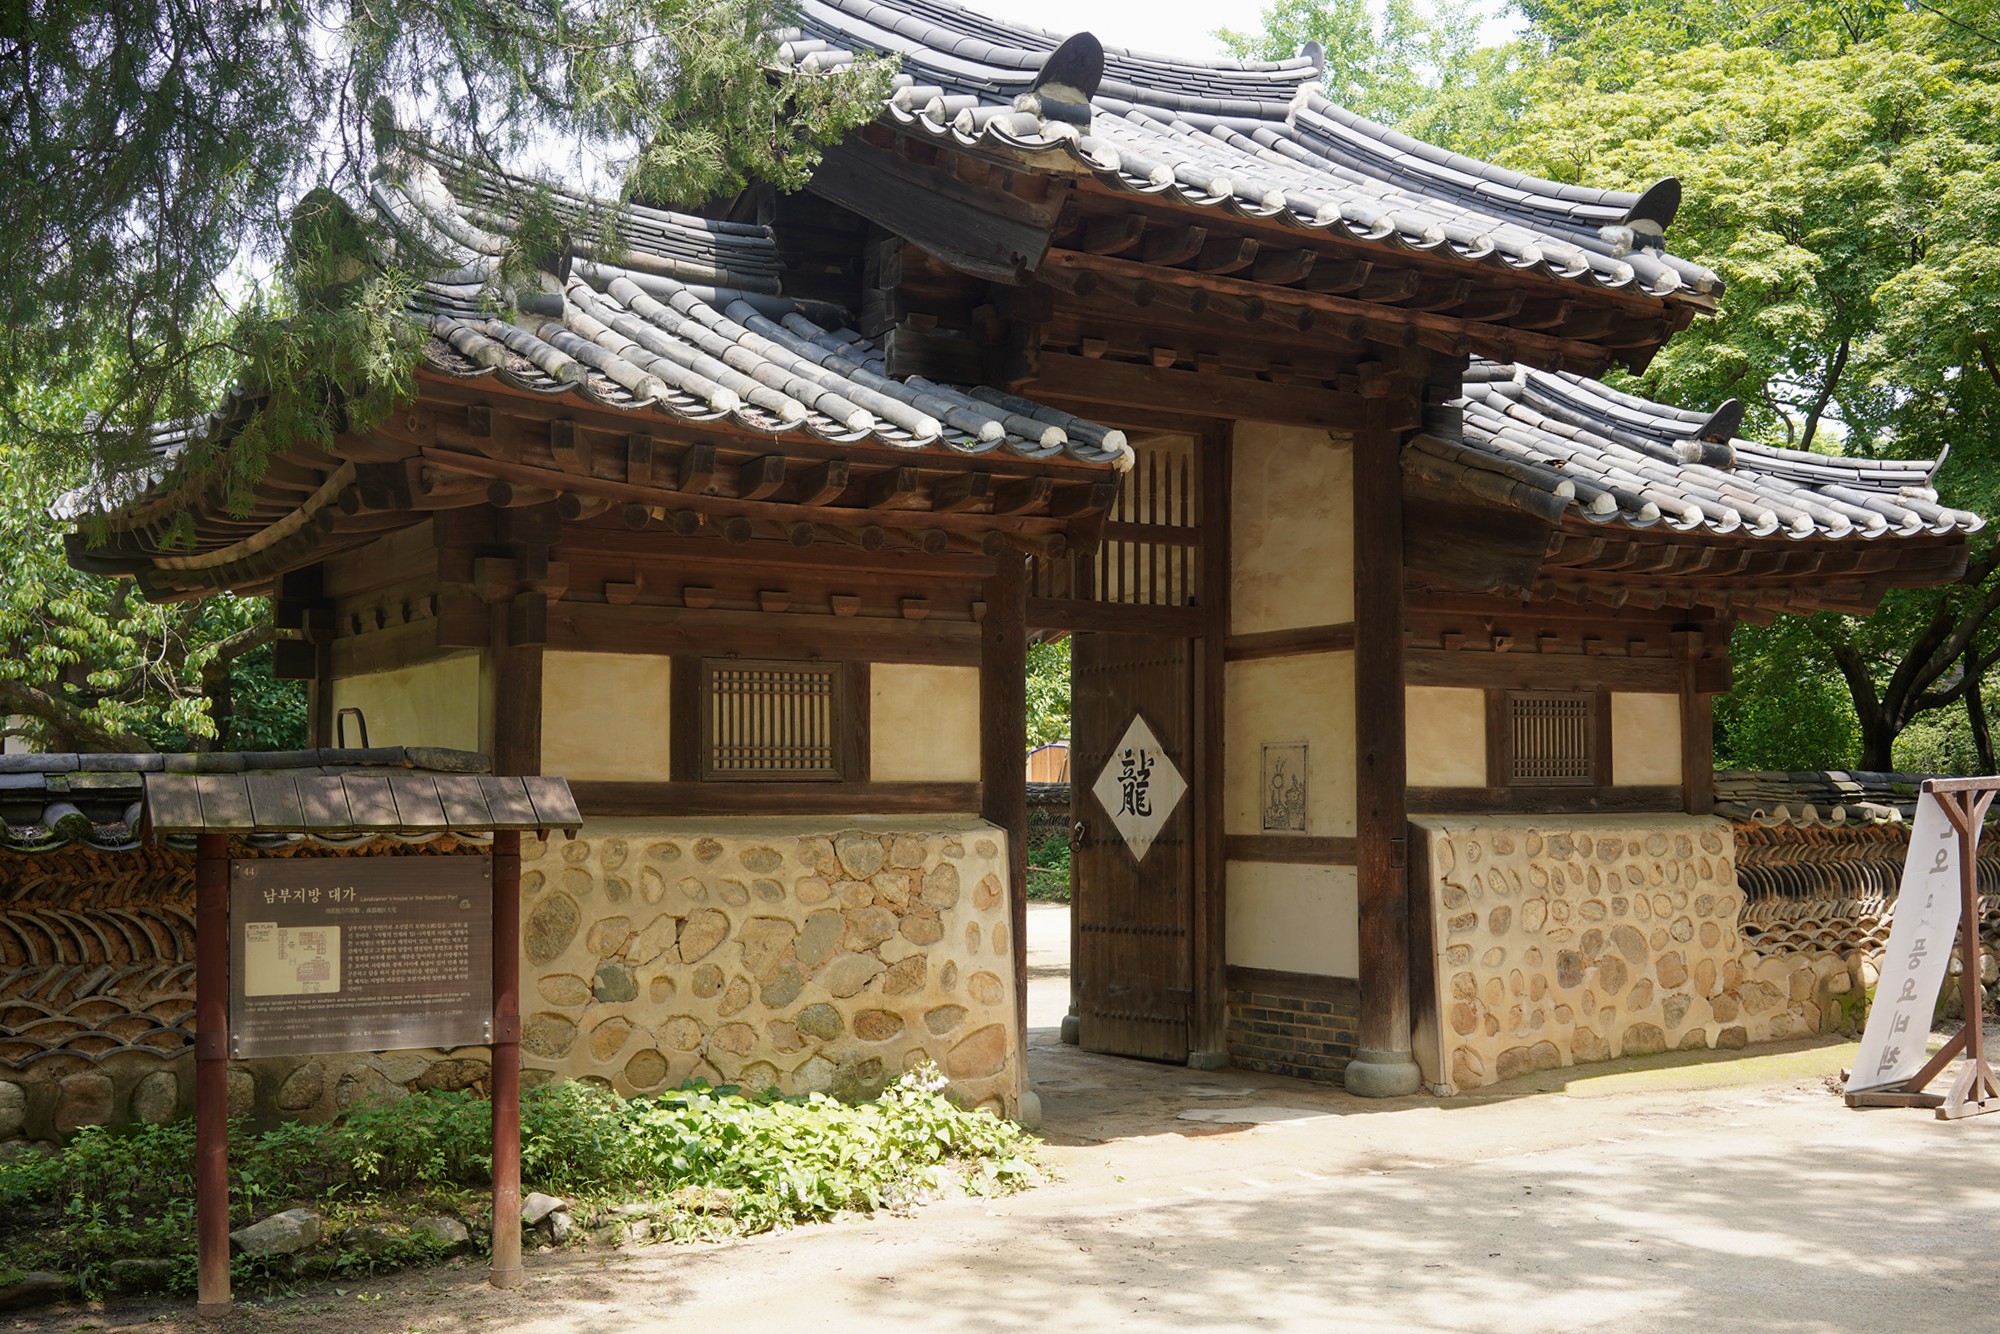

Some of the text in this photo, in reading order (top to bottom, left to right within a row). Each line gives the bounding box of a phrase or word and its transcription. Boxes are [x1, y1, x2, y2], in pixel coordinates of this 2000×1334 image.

[1117, 749, 1154, 817] 龍
[243, 867, 255, 876] 44
[264, 887, 356, 904] 남부지방 대가
